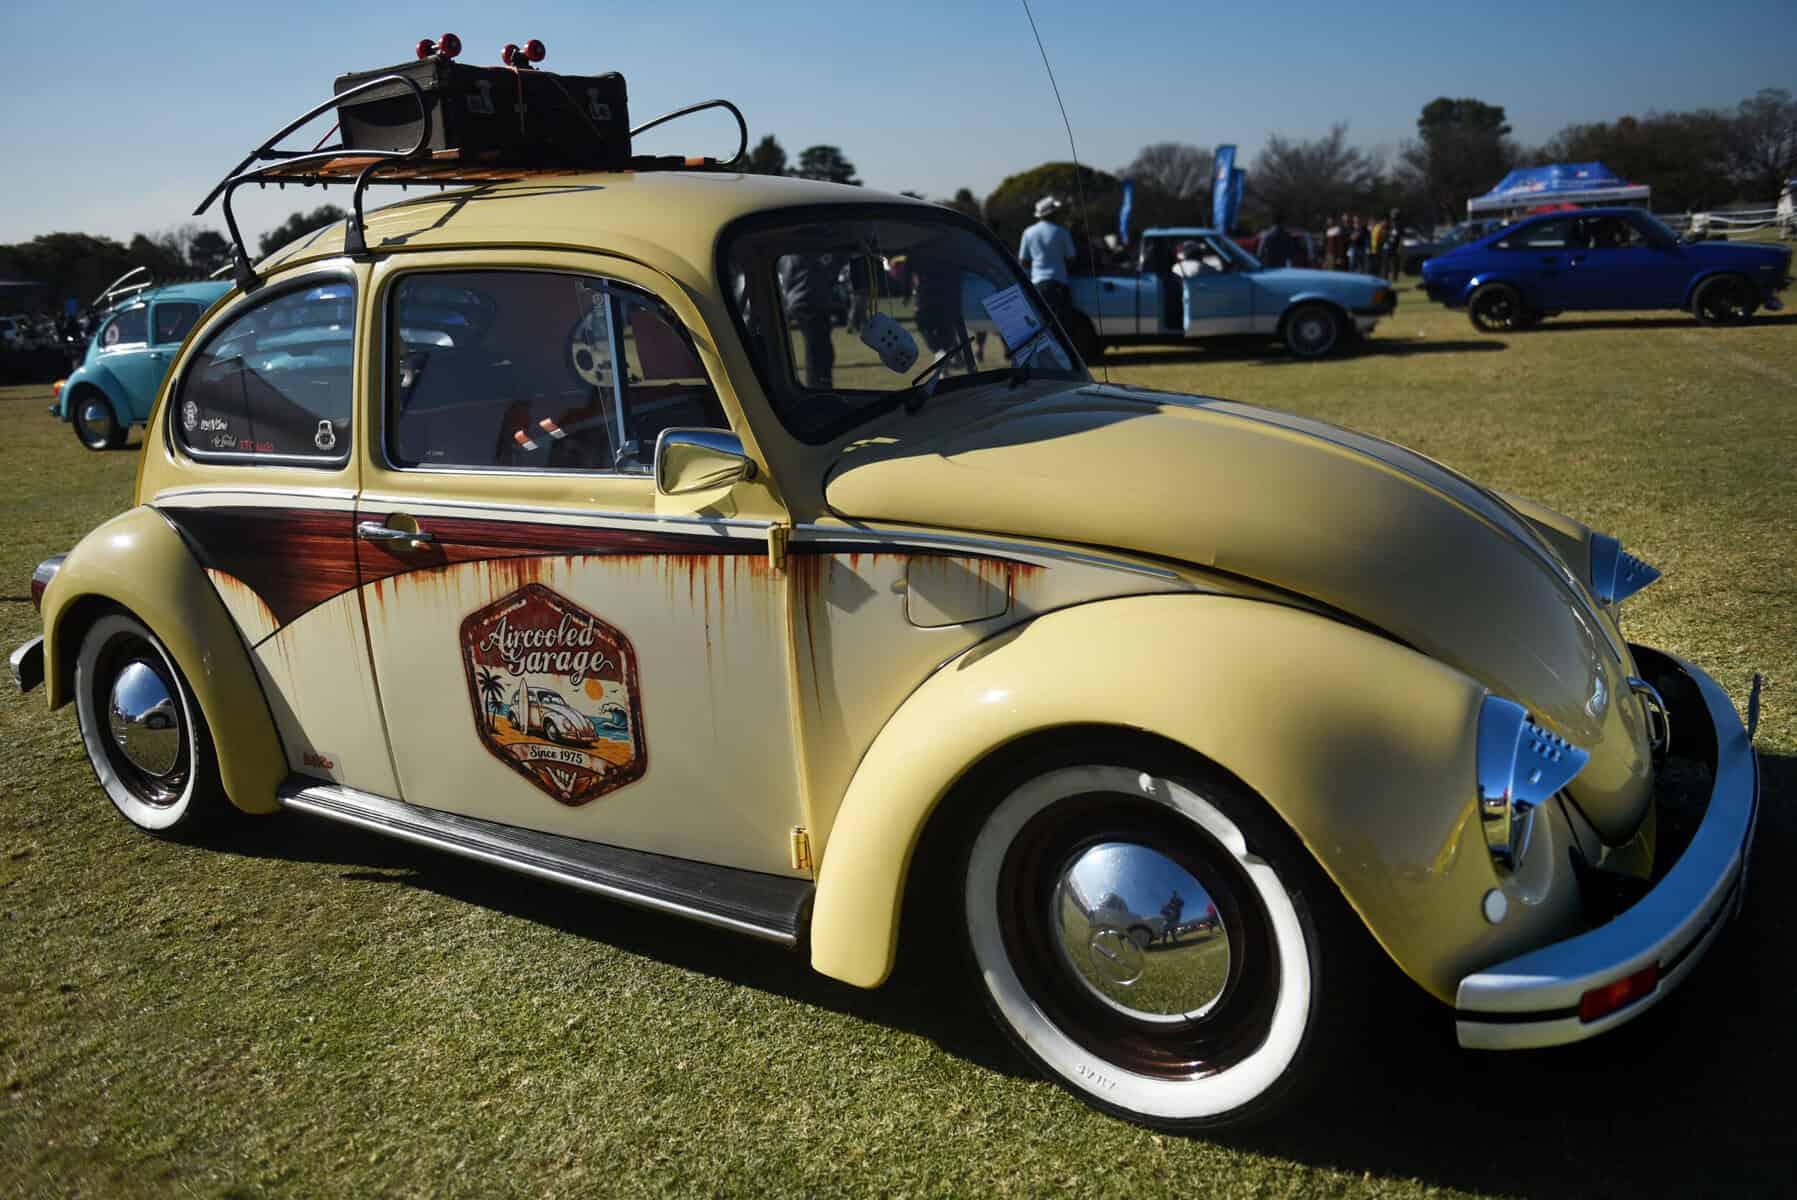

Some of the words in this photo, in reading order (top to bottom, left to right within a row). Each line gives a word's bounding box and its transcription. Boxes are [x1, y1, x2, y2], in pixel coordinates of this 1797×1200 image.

[480, 613, 594, 651] Aircooled
[501, 644, 614, 686] Garage
[530, 745, 556, 759] Since
[559, 750, 584, 764] 1975
